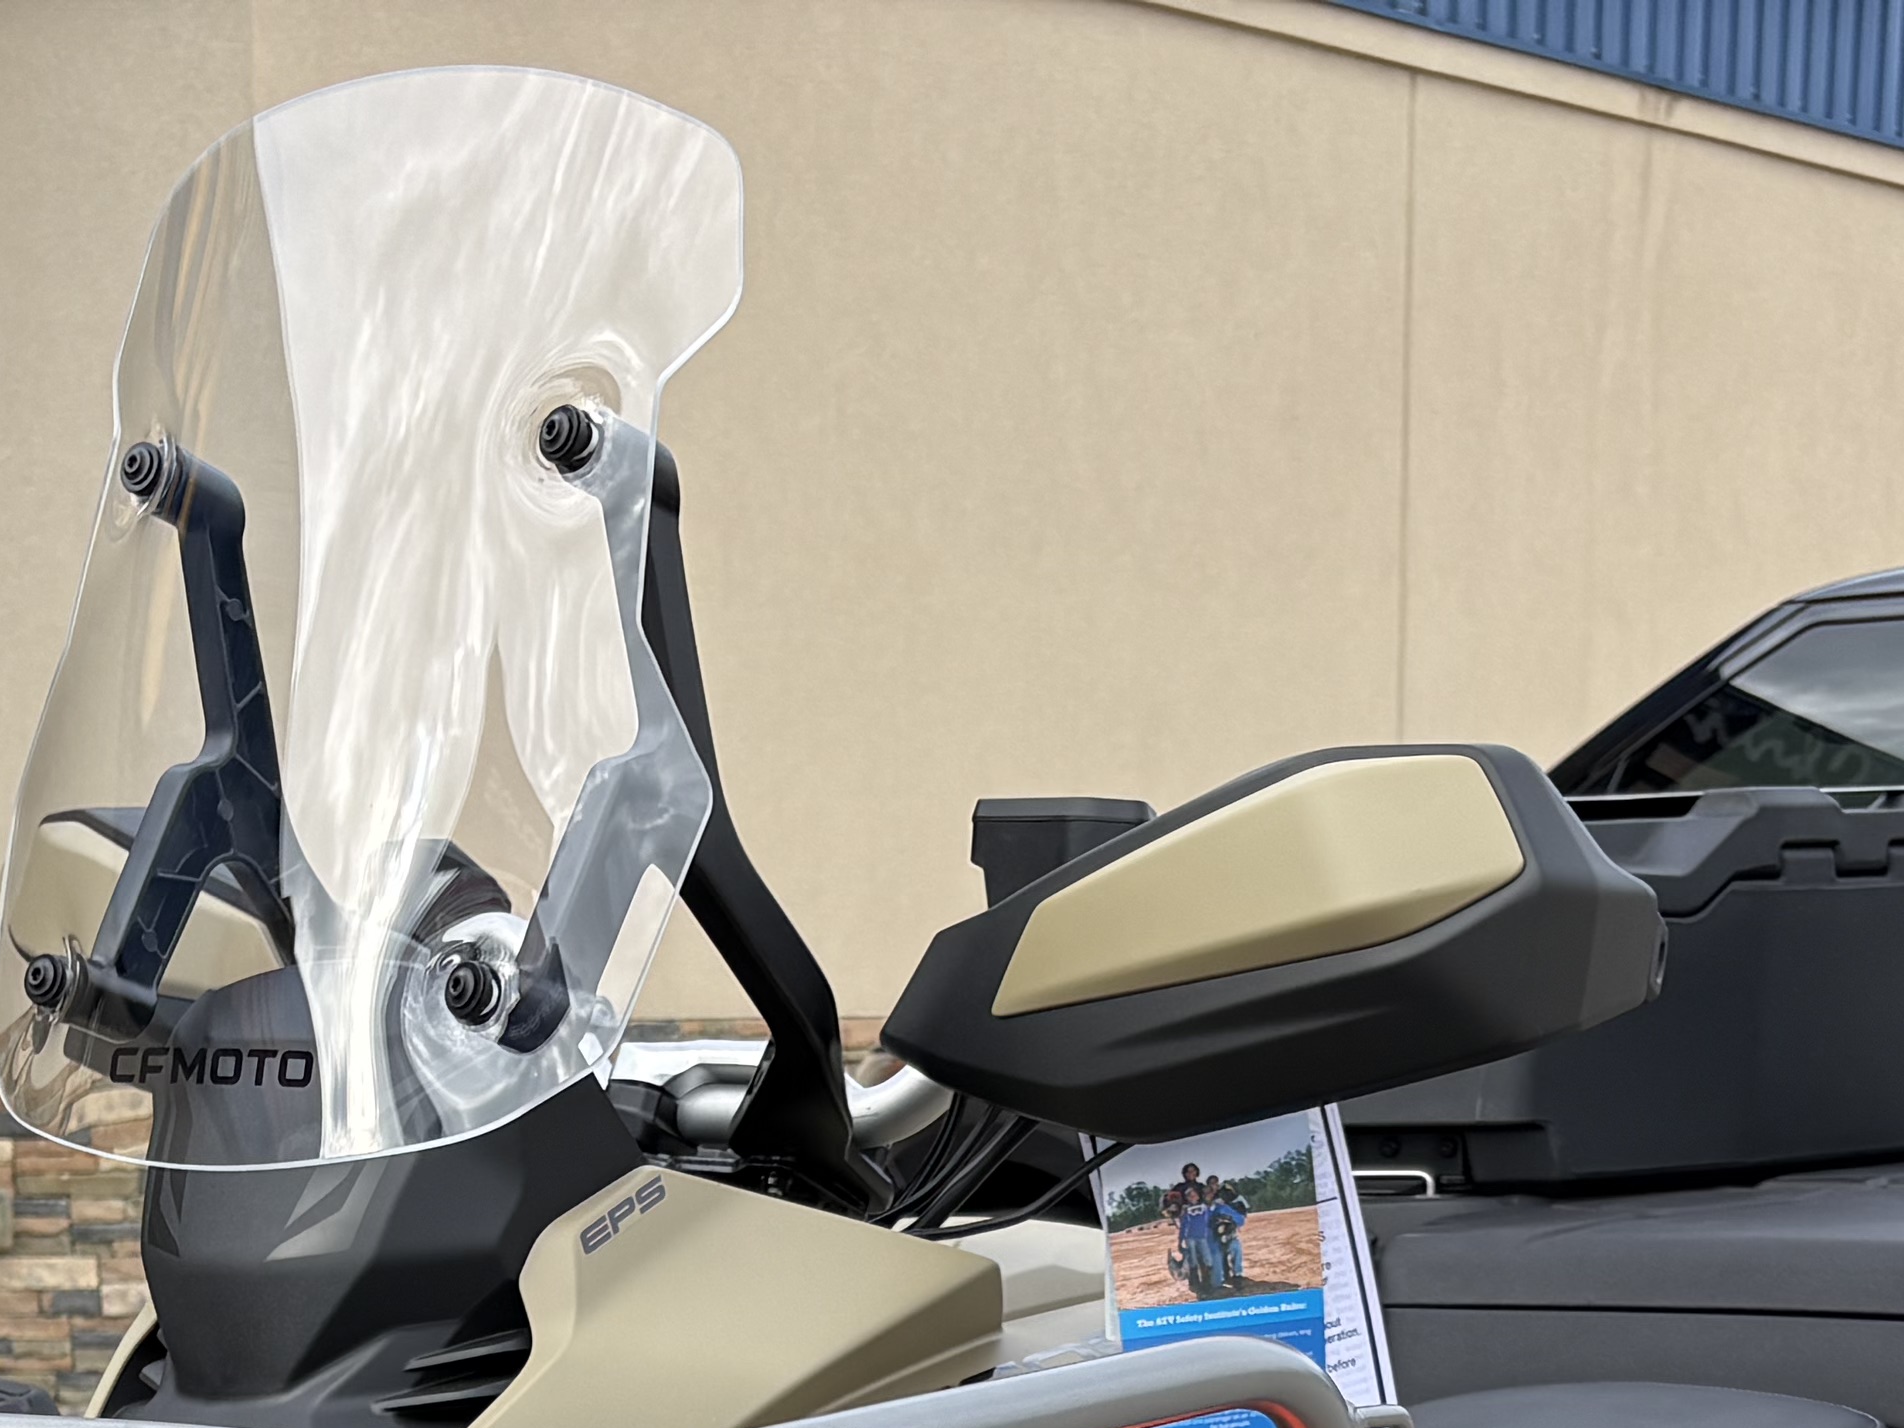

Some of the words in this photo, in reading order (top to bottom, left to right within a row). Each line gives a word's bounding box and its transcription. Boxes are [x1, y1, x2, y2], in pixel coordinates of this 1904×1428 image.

[108, 1046, 314, 1088] CFMOTO
[579, 1174, 668, 1256] EPS
[1327, 1357, 1357, 1374] before
